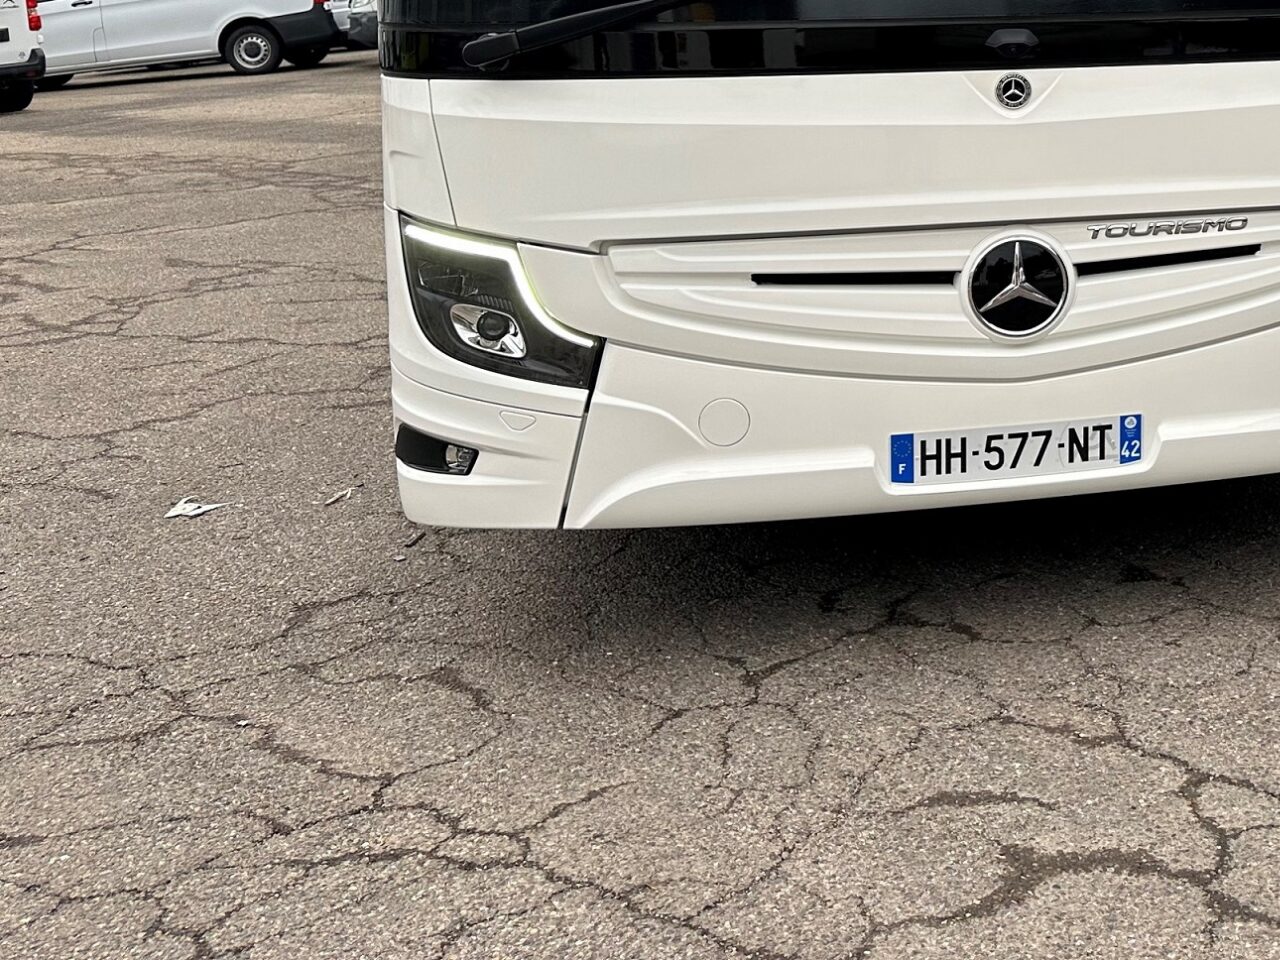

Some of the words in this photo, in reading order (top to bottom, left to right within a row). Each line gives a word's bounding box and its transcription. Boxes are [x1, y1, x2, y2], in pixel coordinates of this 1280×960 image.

[1086, 215, 1249, 240] TOURISMO
[919, 423, 1113, 477] HH-577-NT
[1120, 439, 1141, 458] 42
[898, 463, 906, 476] F
